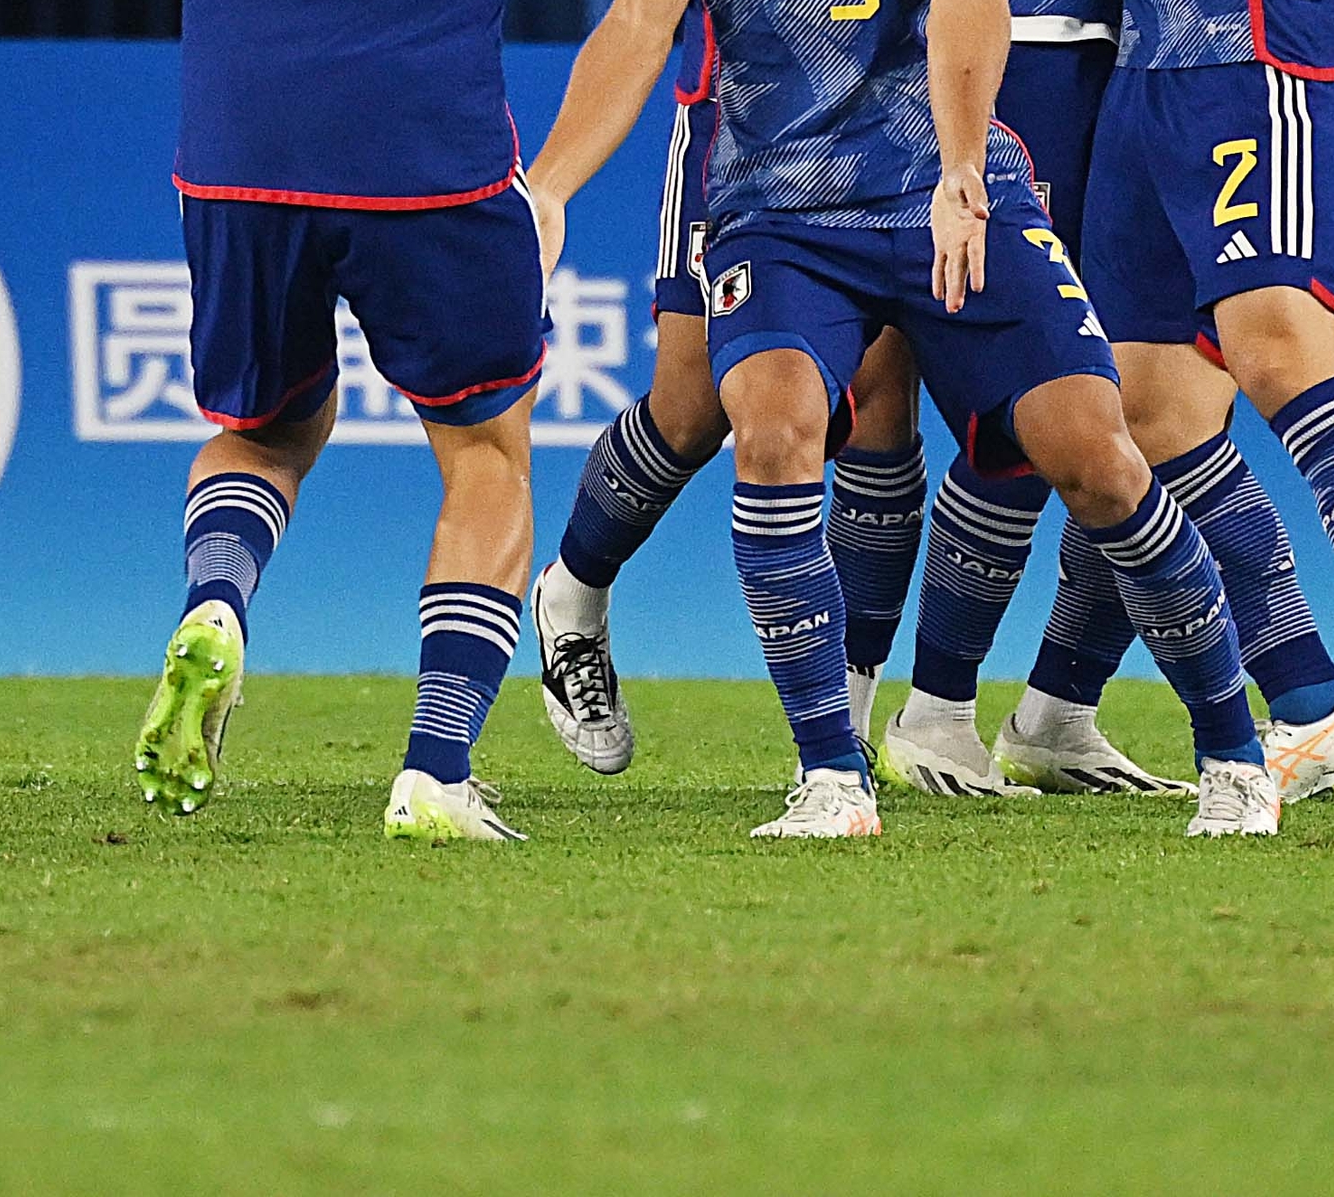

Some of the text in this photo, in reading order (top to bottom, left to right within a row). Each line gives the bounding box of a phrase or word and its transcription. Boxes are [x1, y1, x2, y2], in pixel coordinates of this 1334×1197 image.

[1212, 138, 1258, 227] 2
[1021, 227, 1088, 304] 3
[755, 611, 829, 639] APAN
